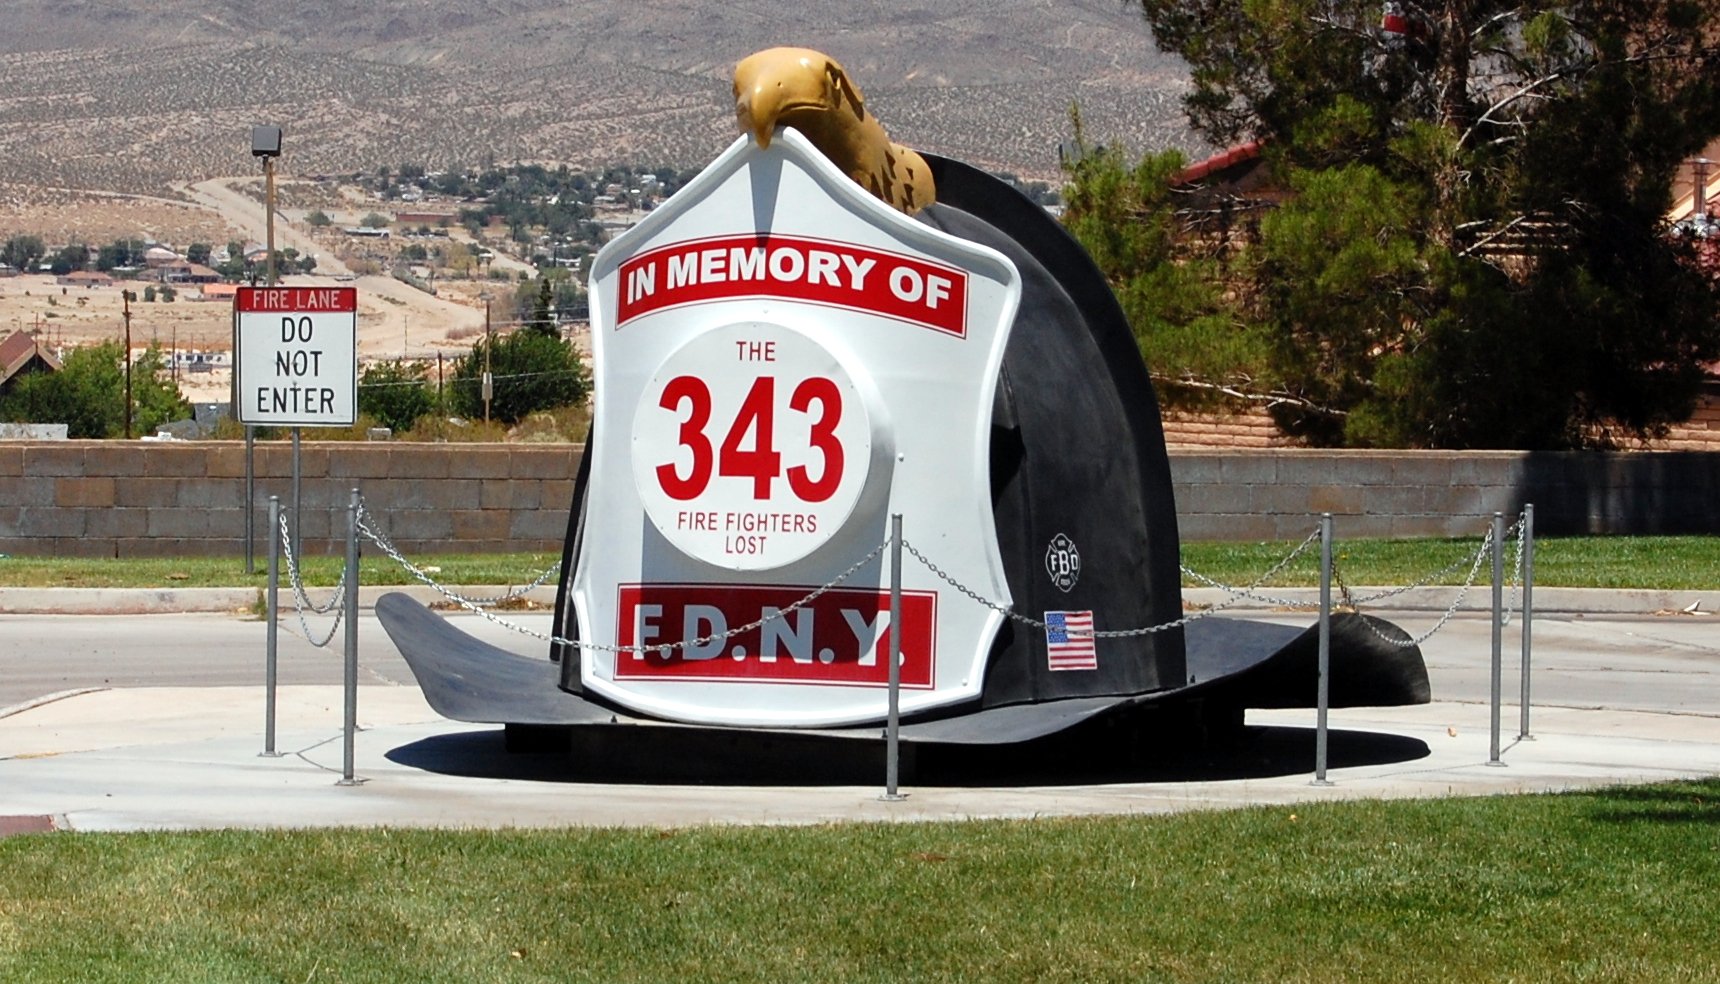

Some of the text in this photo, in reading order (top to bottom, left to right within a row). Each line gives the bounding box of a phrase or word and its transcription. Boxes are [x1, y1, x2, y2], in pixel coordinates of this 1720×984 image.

[627, 246, 952, 309] IN MEMORY OF
[253, 290, 341, 309] FIRE LANE
[281, 316, 313, 343] DO
[276, 350, 323, 377] NOT
[736, 341, 776, 361] THE
[257, 386, 335, 414] ENTER
[655, 375, 845, 503] 343
[678, 511, 818, 533] FIRE FIGHTERS
[725, 536, 767, 555] LOST
